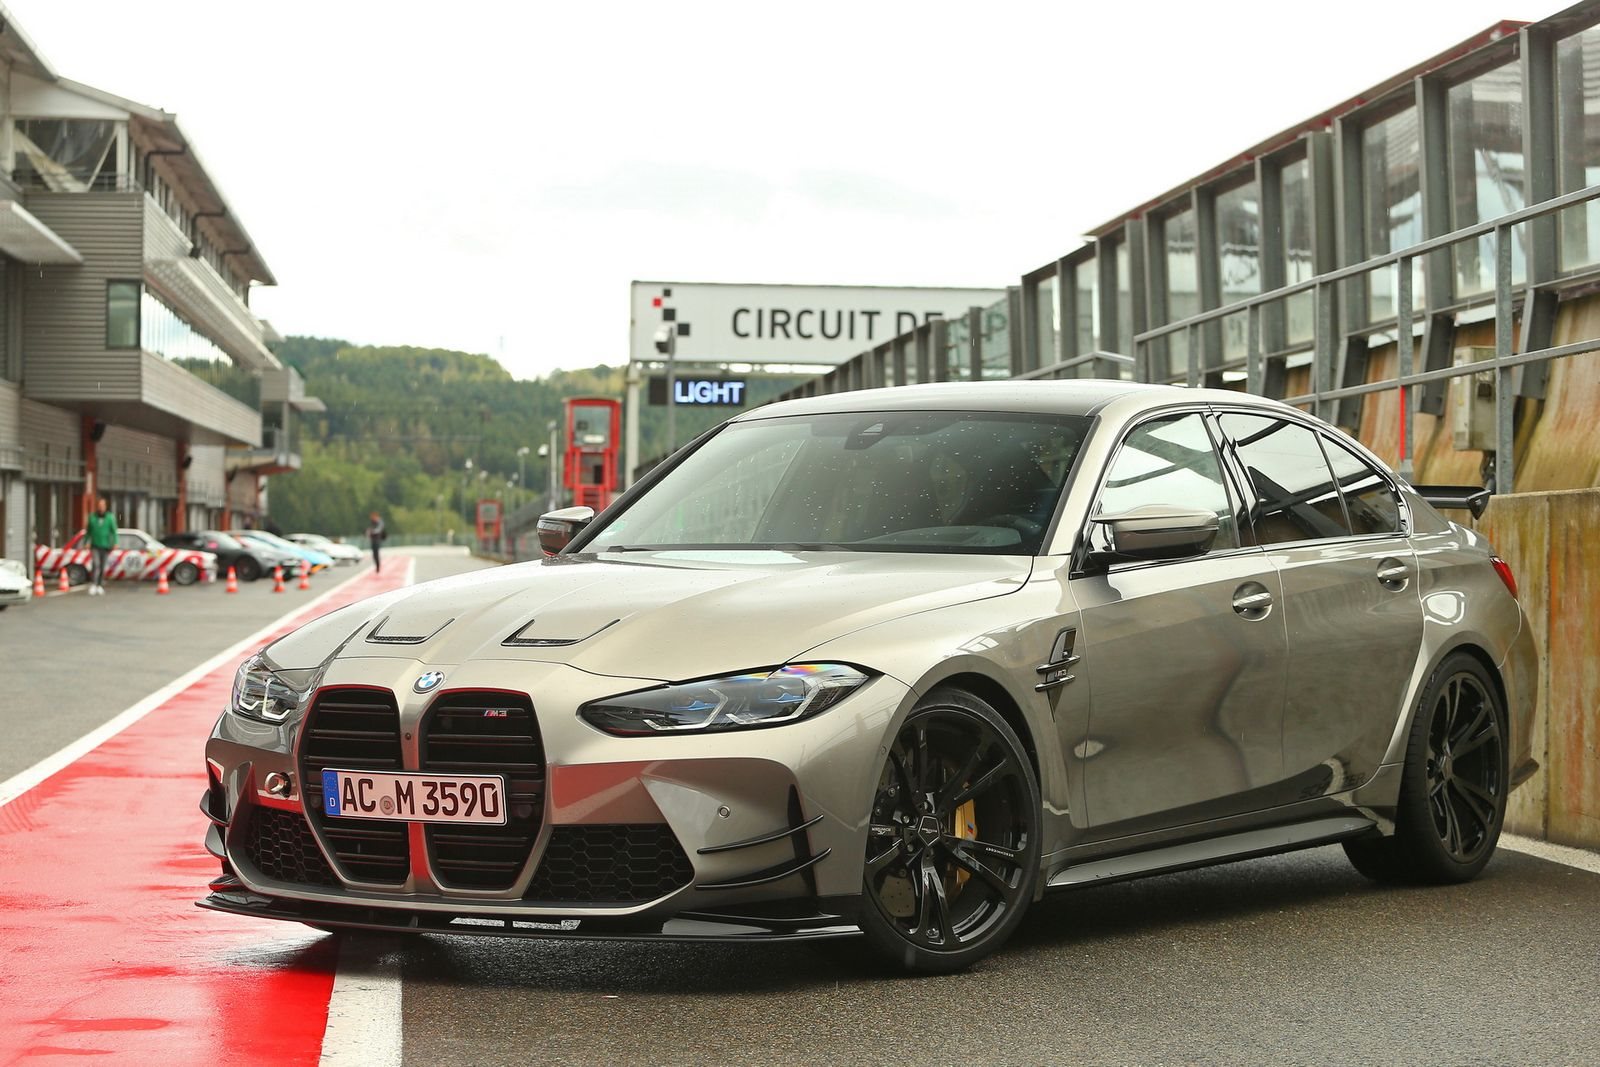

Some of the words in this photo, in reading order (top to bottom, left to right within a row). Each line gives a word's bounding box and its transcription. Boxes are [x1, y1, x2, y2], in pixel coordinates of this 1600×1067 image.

[732, 309, 881, 339] CIRCUIT
[675, 381, 744, 403] LIGHT
[329, 797, 337, 807] D
[342, 777, 377, 813] AC
[395, 779, 415, 815] M
[422, 781, 499, 818] 3590
